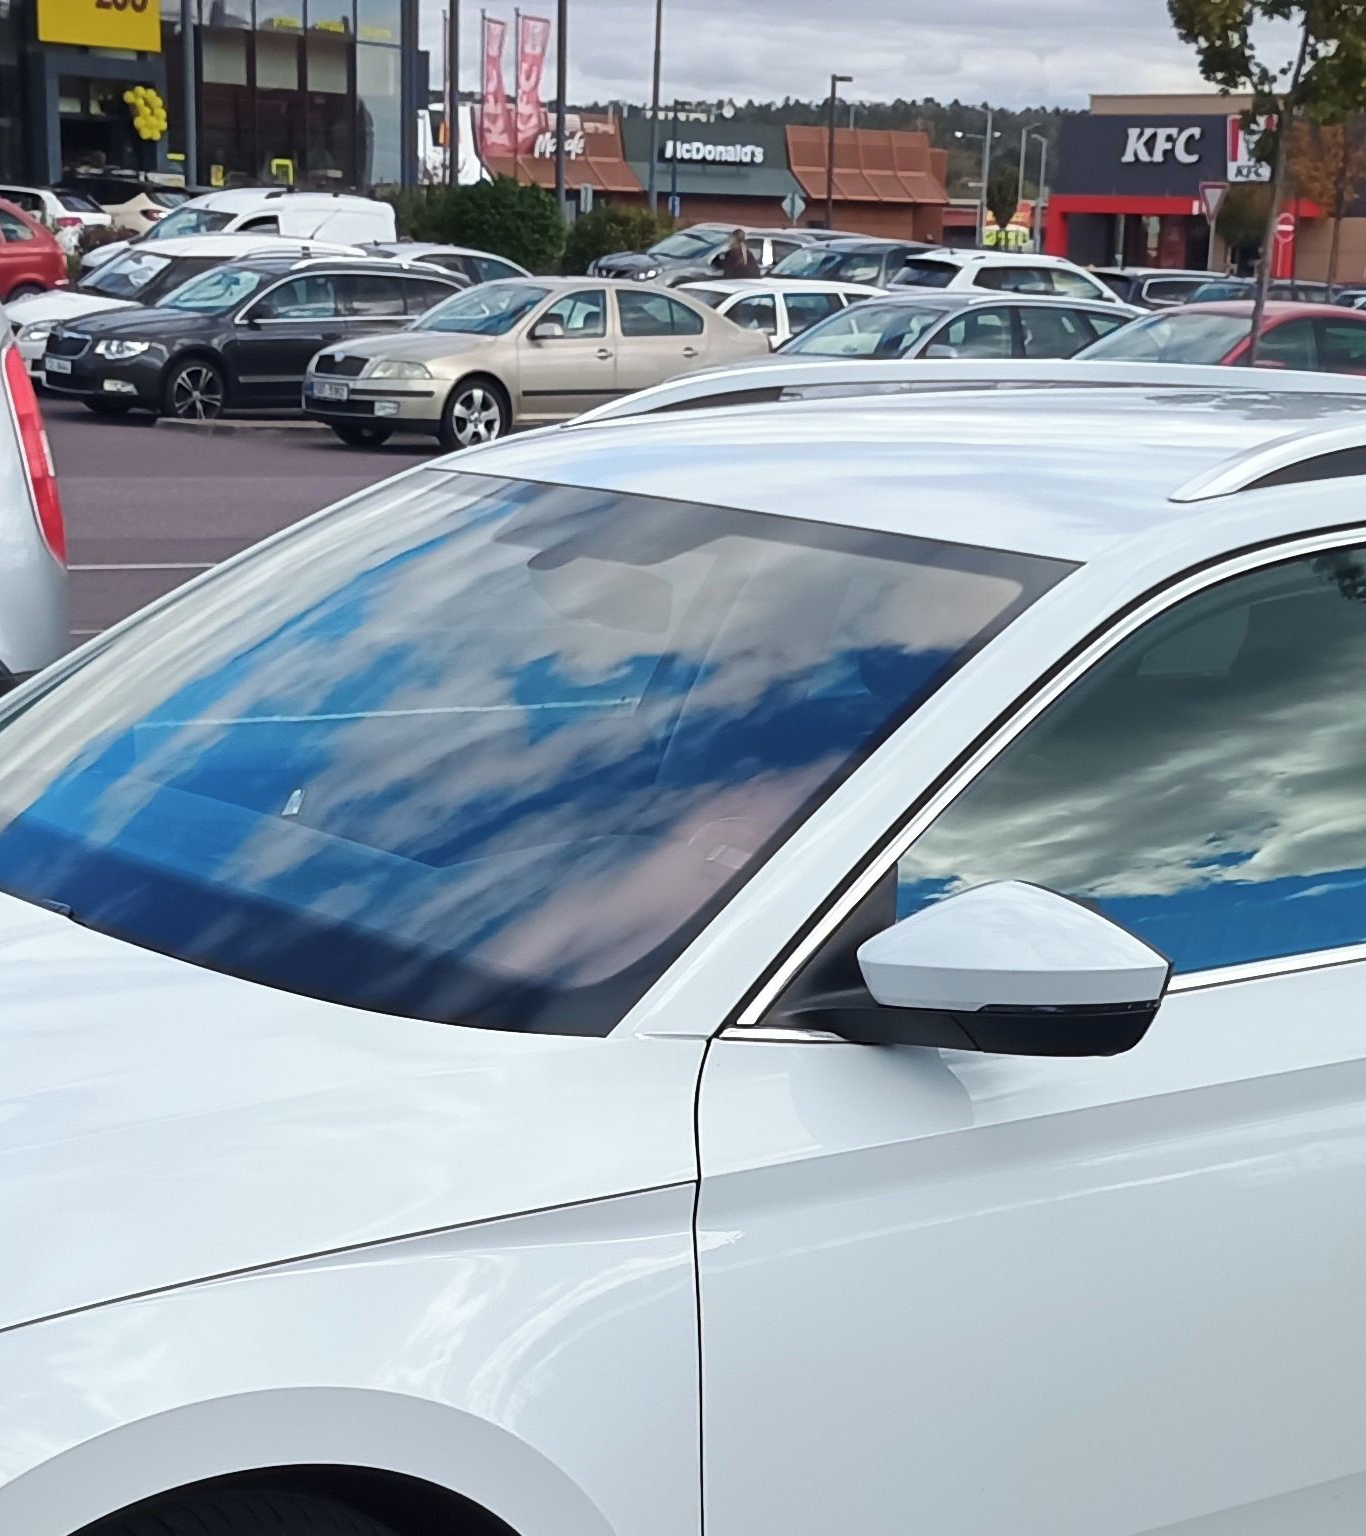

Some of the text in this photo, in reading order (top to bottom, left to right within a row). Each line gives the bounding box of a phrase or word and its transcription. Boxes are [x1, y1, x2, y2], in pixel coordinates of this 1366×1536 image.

[664, 139, 765, 164] McDonald's
[1121, 127, 1202, 164] KFC
[1235, 164, 1264, 179] KFC
